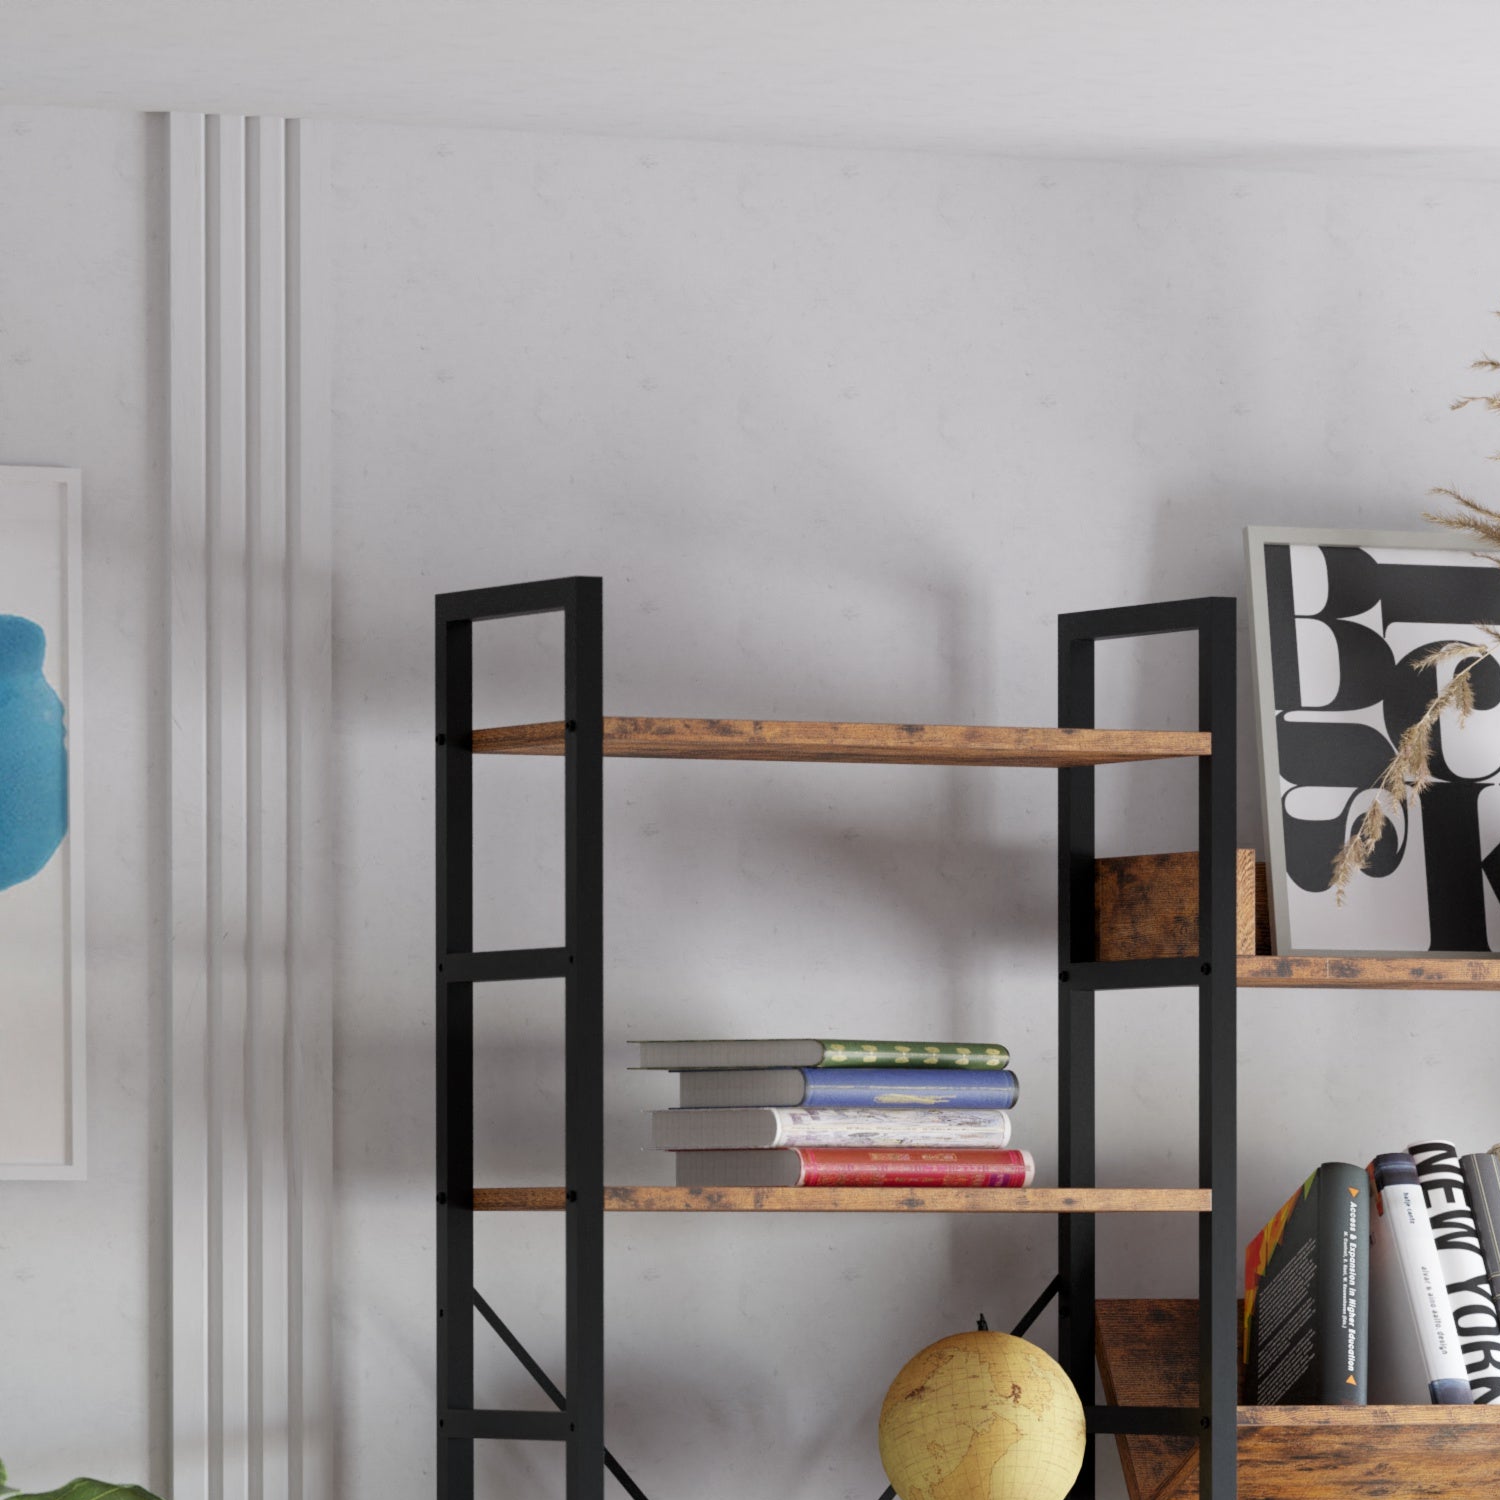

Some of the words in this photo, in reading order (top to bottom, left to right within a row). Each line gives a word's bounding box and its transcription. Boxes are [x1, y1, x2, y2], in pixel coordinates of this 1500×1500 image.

[1349, 1201, 1358, 1232] Access
[1408, 1143, 1484, 1258] NEW
[1348, 1242, 1357, 1286] Expansion
[1348, 1287, 1357, 1297] in
[1347, 1298, 1357, 1327] Higher
[1347, 1328, 1356, 1371] Education
